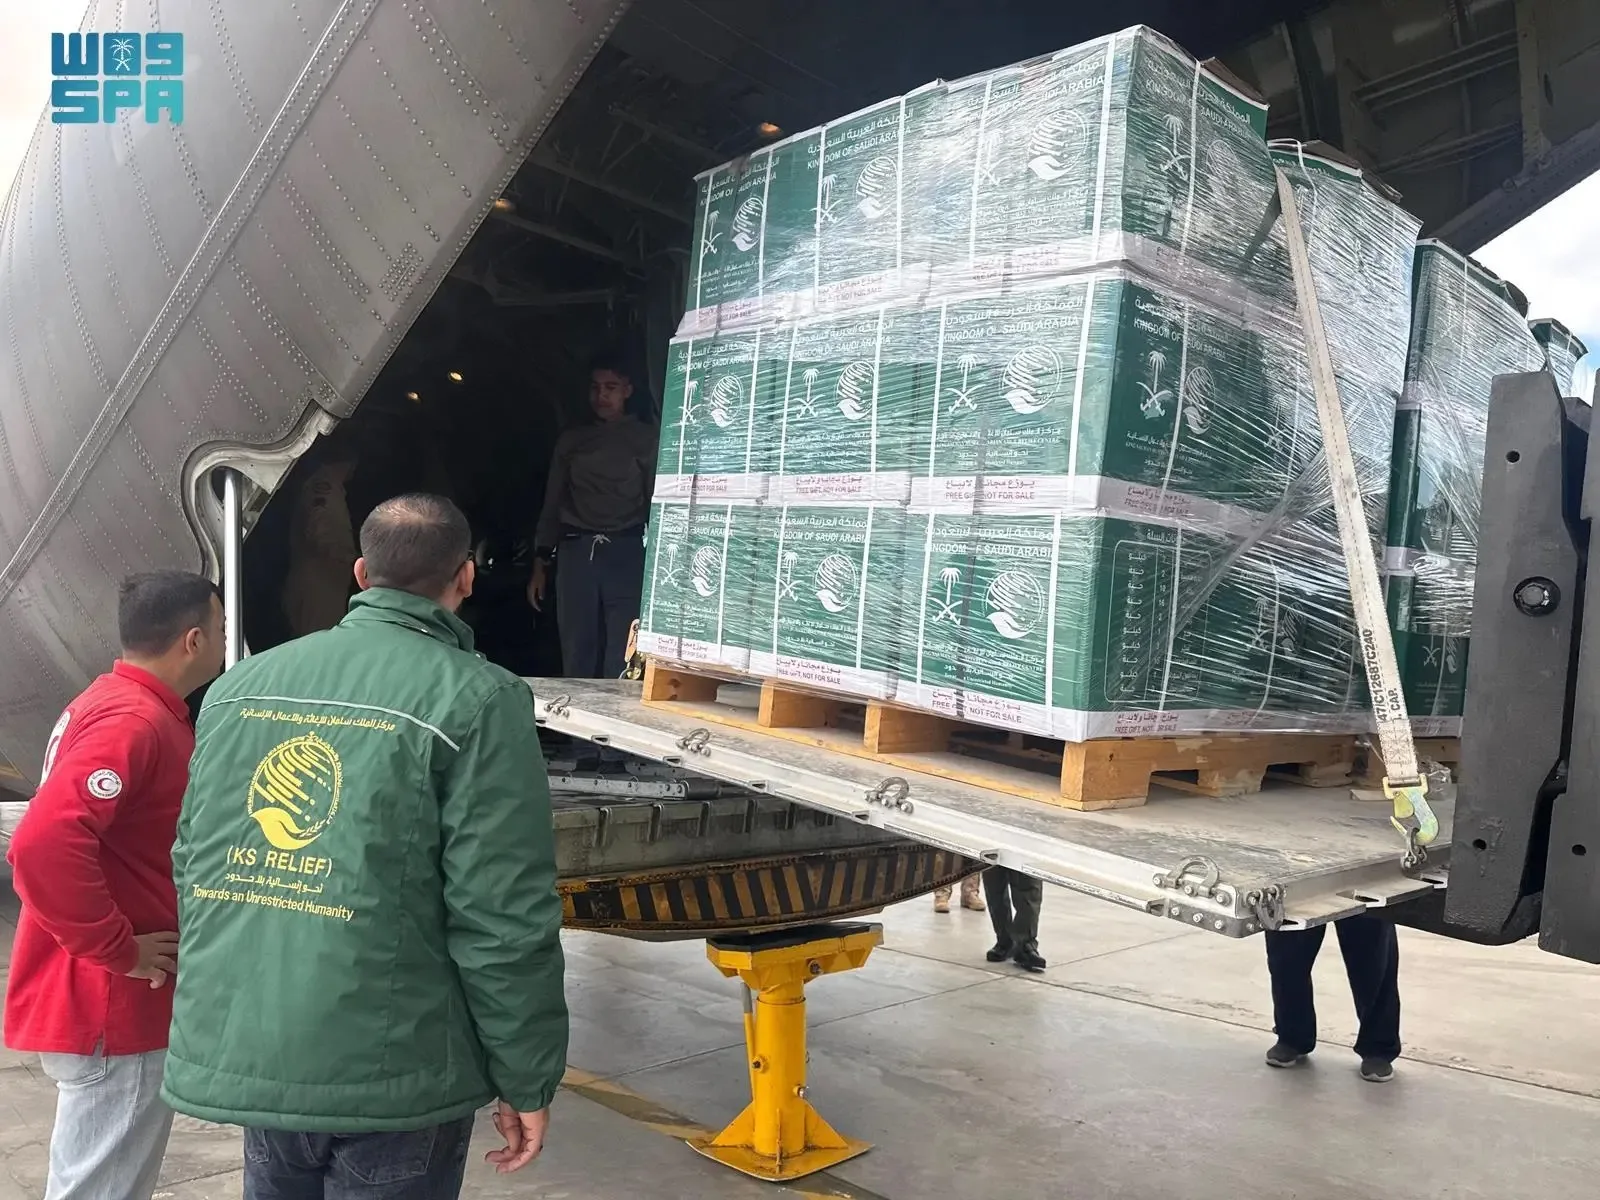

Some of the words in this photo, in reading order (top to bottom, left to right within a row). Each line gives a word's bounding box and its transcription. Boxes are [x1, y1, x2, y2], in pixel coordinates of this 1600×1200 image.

[807, 152, 841, 170] KINDOM
[841, 146, 853, 157] OF
[854, 136, 878, 153] SAUDI
[1002, 321, 1034, 334] SAUDI
[1035, 316, 1080, 330] ARABIA
[1133, 317, 1170, 339] KINGDOM
[804, 532, 814, 540] OF
[815, 532, 838, 541] SAUDI
[839, 533, 866, 543] ARABI
[983, 544, 1016, 555] SAUDI
[1017, 546, 1053, 558] ARABI
[803, 672, 813, 680] NOT
[815, 674, 825, 682] FOR
[826, 676, 841, 684] SALE
[1388, 687, 1401, 711] CAP.
[932, 700, 950, 708] FREE
[970, 707, 984, 716] NOT
[986, 710, 1001, 719] FOR
[1002, 713, 1022, 723] SALE
[328, 715, 352, 727] سلمان
[375, 719, 396, 731] مركز
[226, 844, 257, 866] (KS
[264, 850, 333, 878] RELIEF)
[224, 871, 255, 883] حدود
[266, 875, 302, 895] إنسانية
[302, 882, 324, 894] نحو
[192, 884, 230, 900] Towards
[231, 891, 244, 901] an
[245, 890, 304, 912] Unrestricted
[304, 900, 355, 922] Humanity
